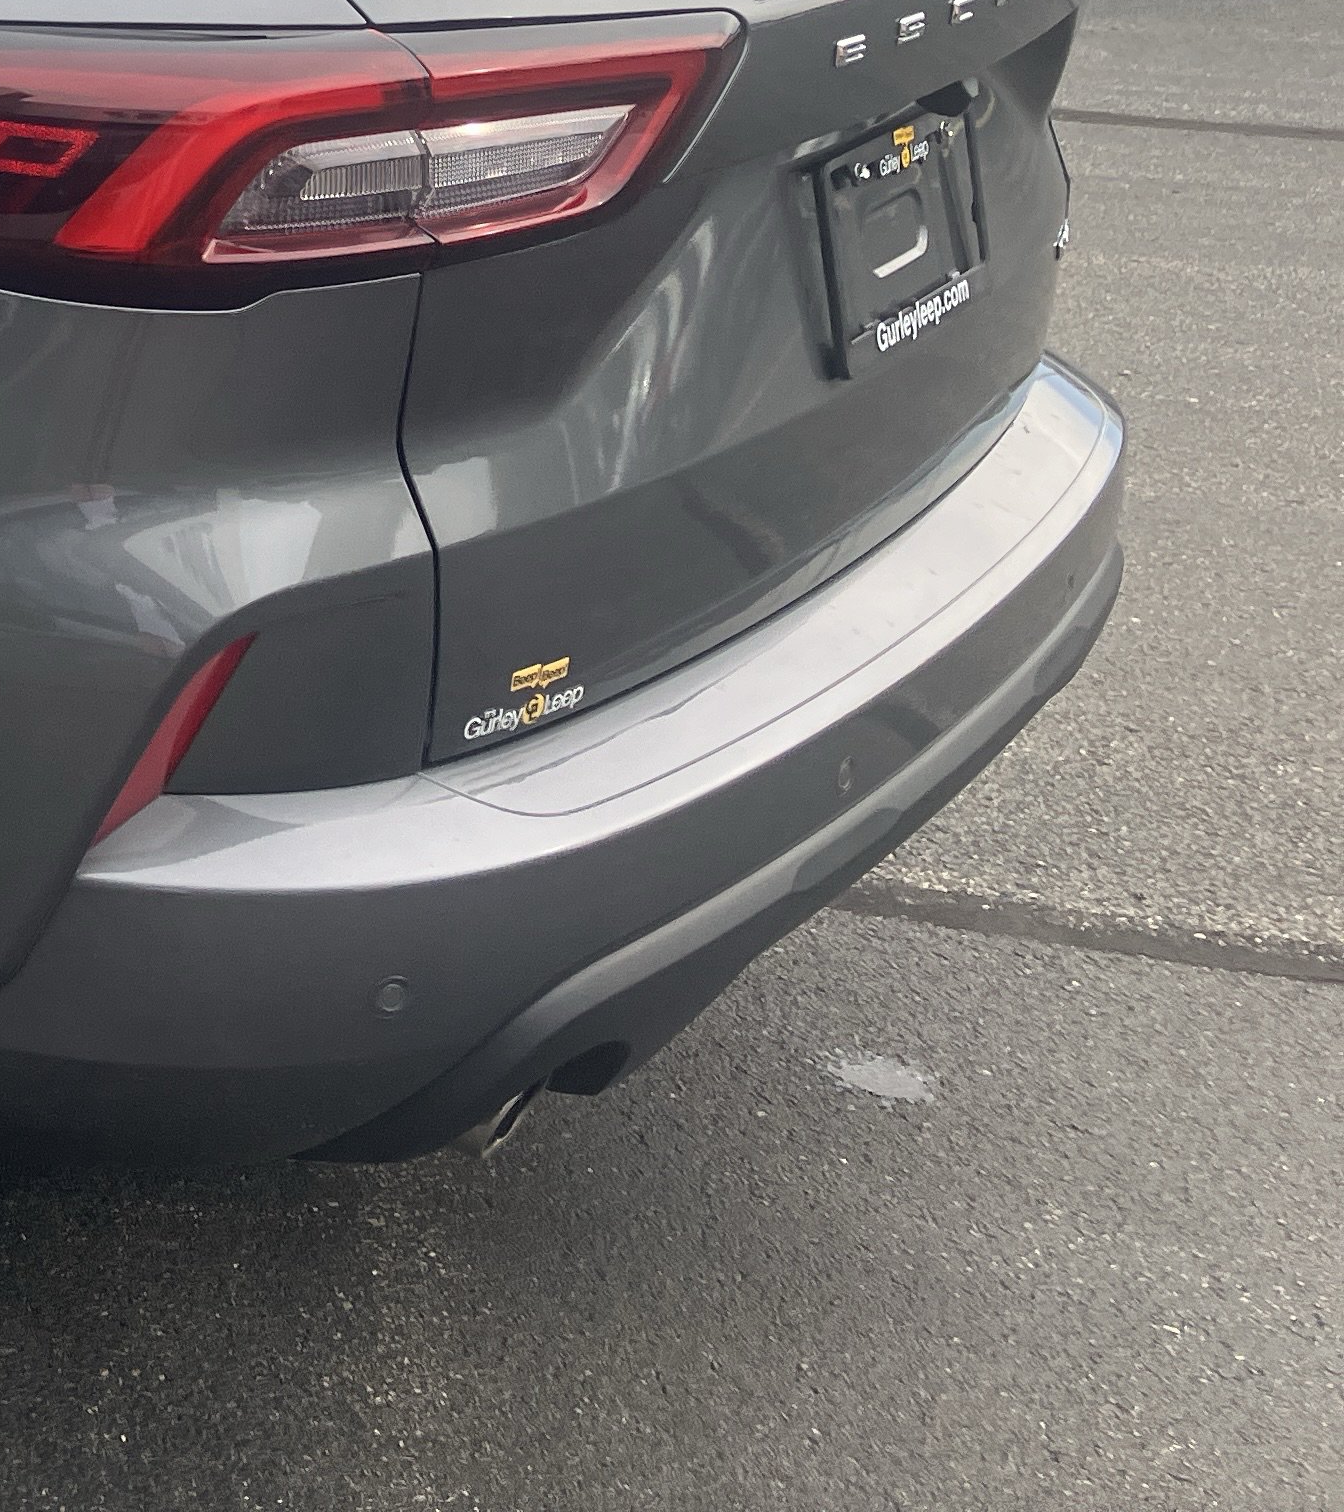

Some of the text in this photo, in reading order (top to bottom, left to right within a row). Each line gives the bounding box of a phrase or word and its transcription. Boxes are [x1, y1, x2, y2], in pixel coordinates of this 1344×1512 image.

[876, 279, 970, 352] Gurleyleep.com
[464, 685, 584, 740] Gurley Leep
